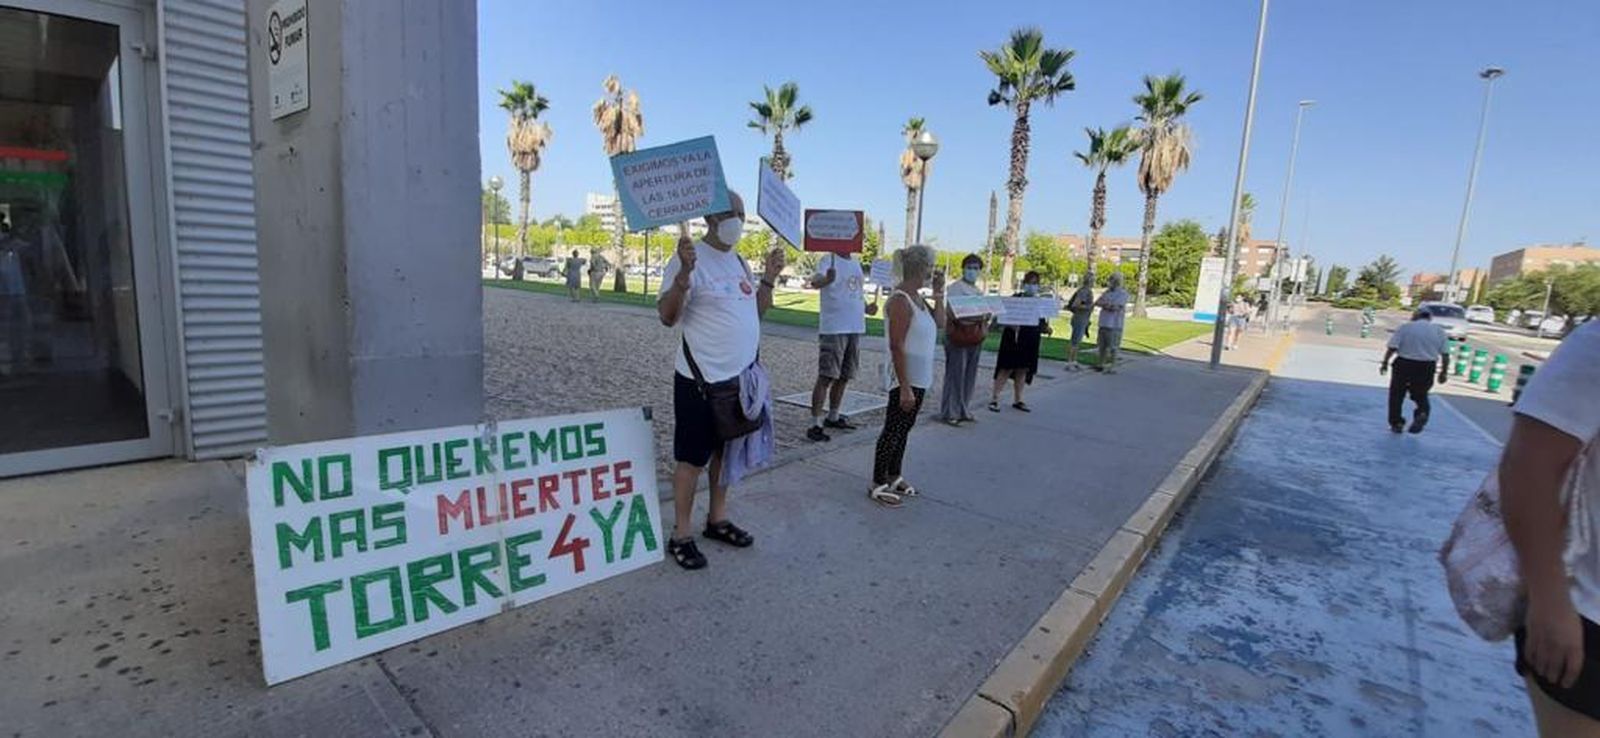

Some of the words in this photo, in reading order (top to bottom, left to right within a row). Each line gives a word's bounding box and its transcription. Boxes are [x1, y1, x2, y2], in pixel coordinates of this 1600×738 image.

[623, 157, 680, 176] EXIGIMOS
[632, 170, 693, 189] APERTURA
[694, 167, 711, 178] DE
[642, 191, 664, 205] LAS
[648, 198, 710, 218] CERRADAS
[272, 453, 353, 507] NO
[378, 422, 606, 494] QUEREMOS
[275, 501, 408, 570] MAS
[436, 460, 634, 535] MUERTES
[285, 530, 547, 652] TORRE
